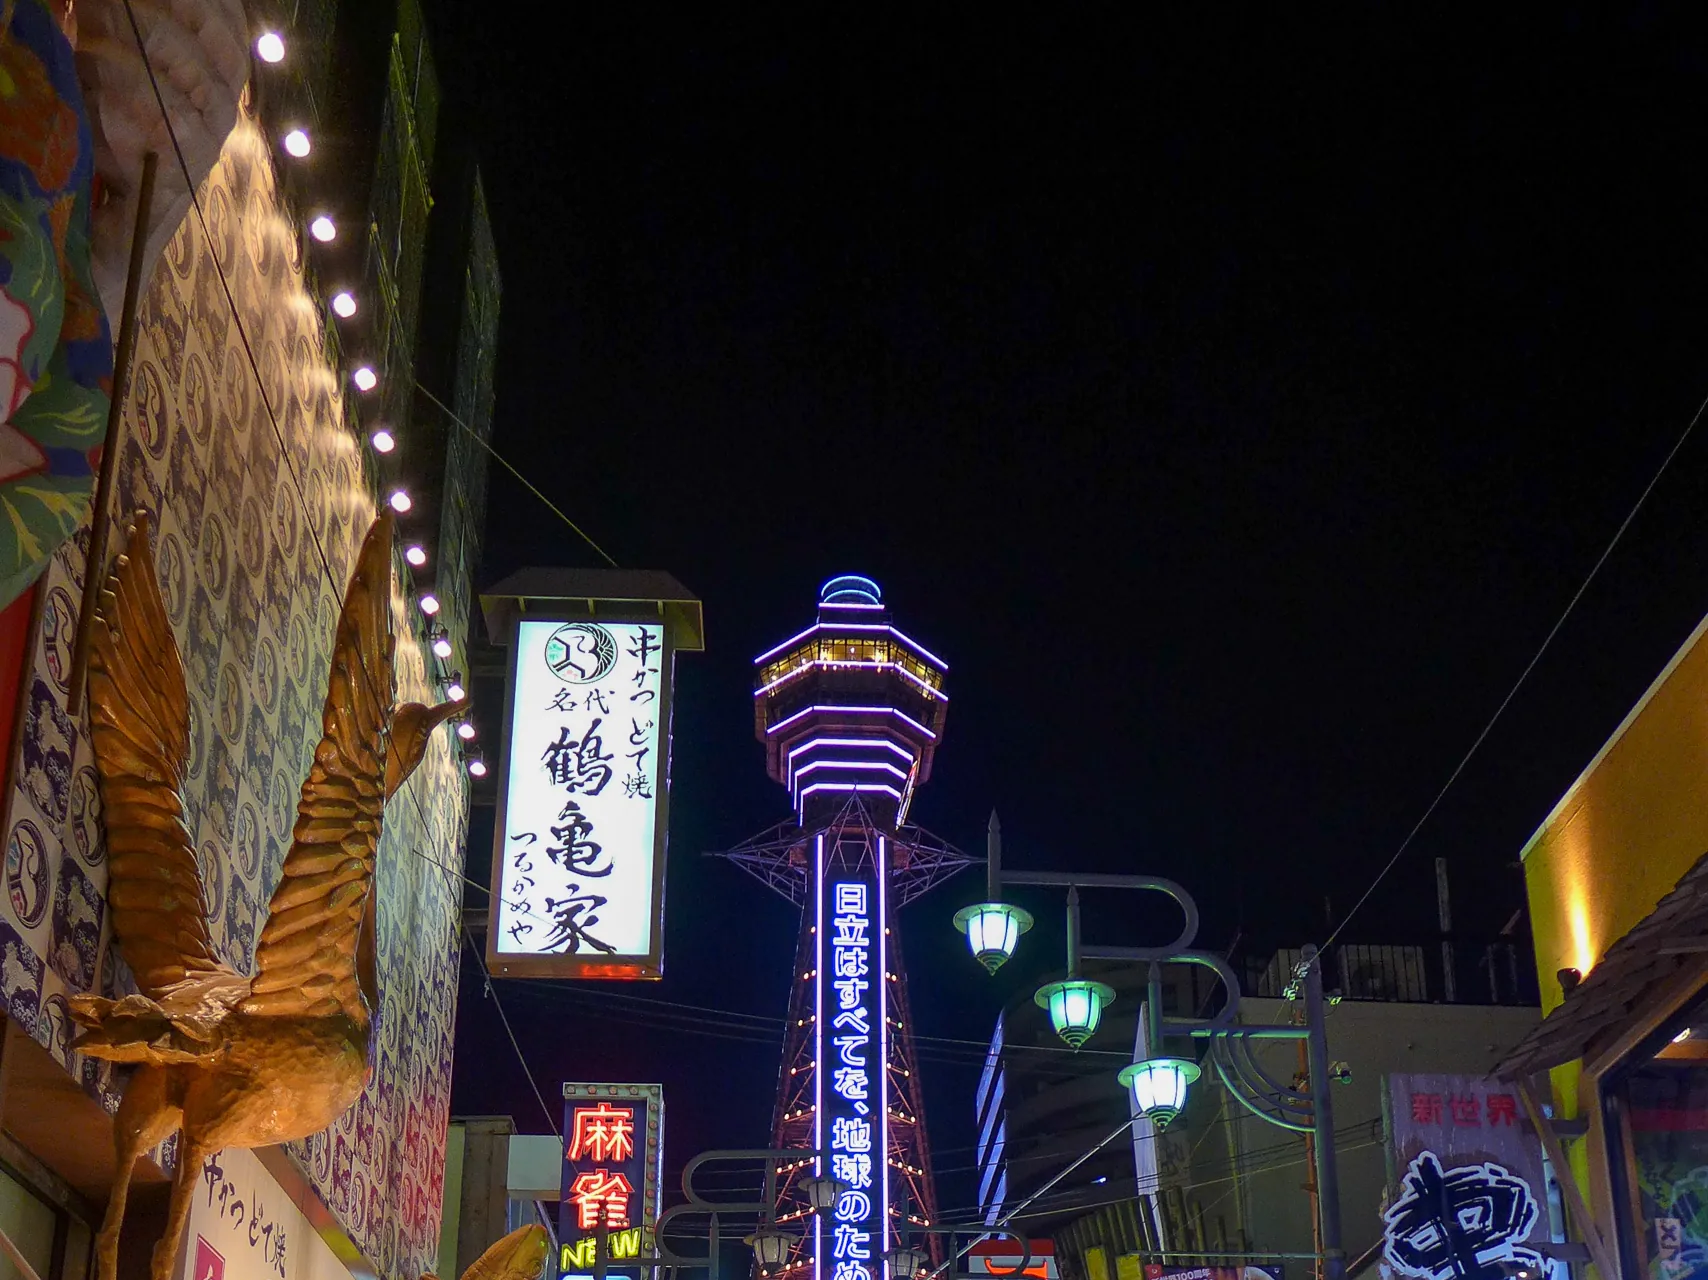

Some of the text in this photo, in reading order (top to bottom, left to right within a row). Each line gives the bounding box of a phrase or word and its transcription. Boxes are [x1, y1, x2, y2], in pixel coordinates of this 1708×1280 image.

[544, 687, 615, 715] 名代
[620, 626, 662, 799] 串かつ どて焼
[537, 718, 617, 955] 鶴亀家
[506, 832, 538, 944] つるかめや
[1412, 1093, 1518, 1127] 新世界
[566, 1103, 634, 1229] 麻雀
[248, 1189, 286, 1278] どて焼
[561, 1228, 641, 1272] NEW
